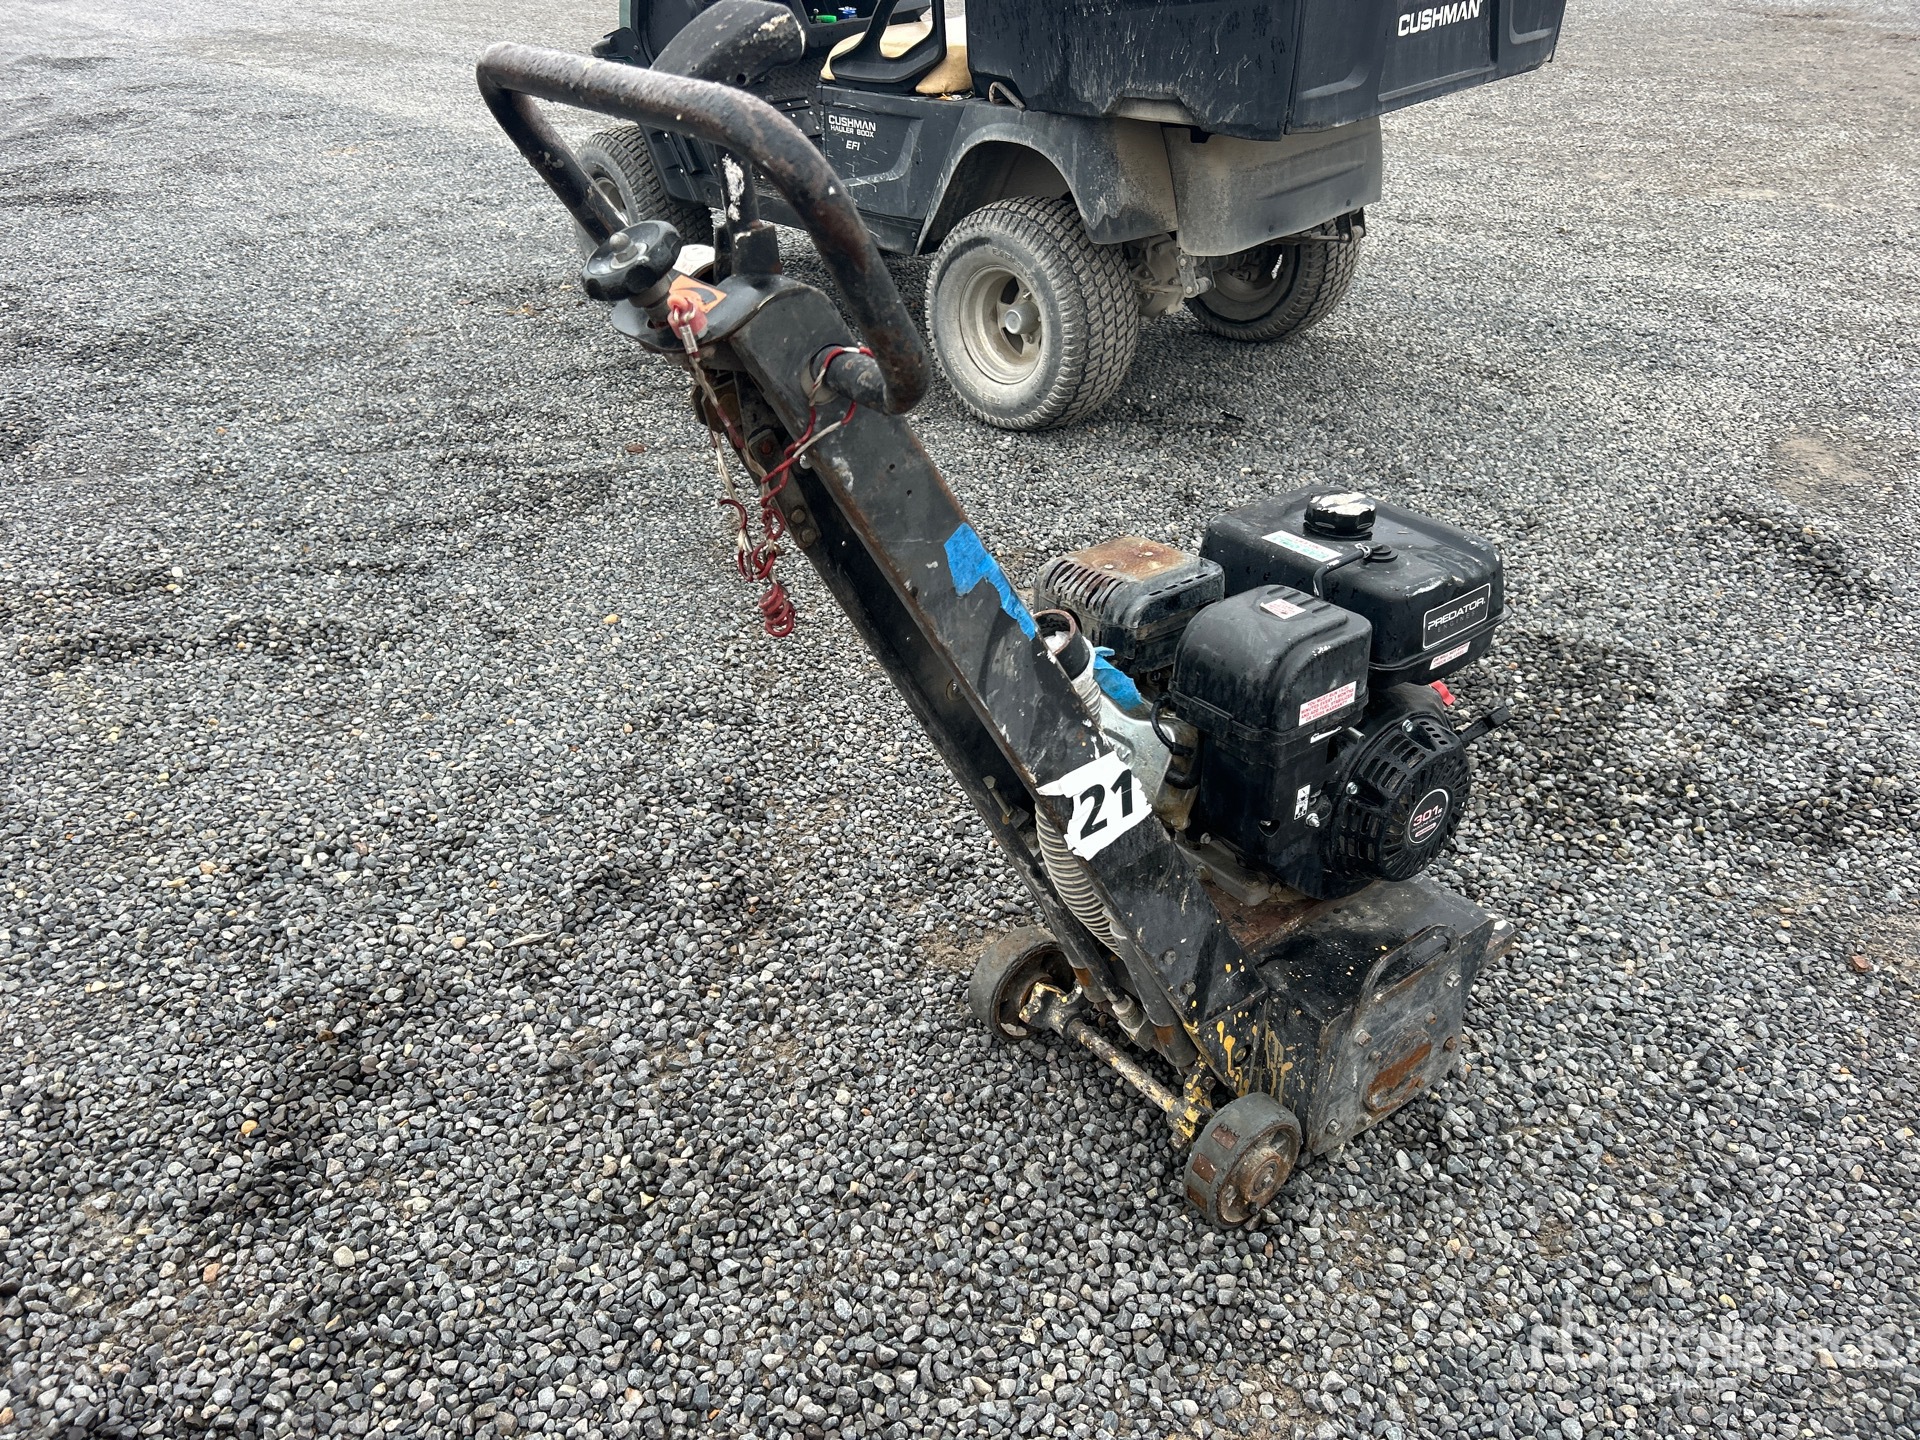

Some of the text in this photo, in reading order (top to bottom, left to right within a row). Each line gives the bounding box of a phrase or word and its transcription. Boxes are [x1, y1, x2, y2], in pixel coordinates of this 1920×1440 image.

[1397, 0, 1481, 37] CUSHMAN
[829, 114, 876, 131] CUSHMAN
[830, 125, 854, 134] HAULER
[846, 140, 860, 151] EFI
[1427, 597, 1485, 631] PREDATOR
[1437, 610, 1476, 633] ENGINES
[1080, 769, 1133, 840] 21
